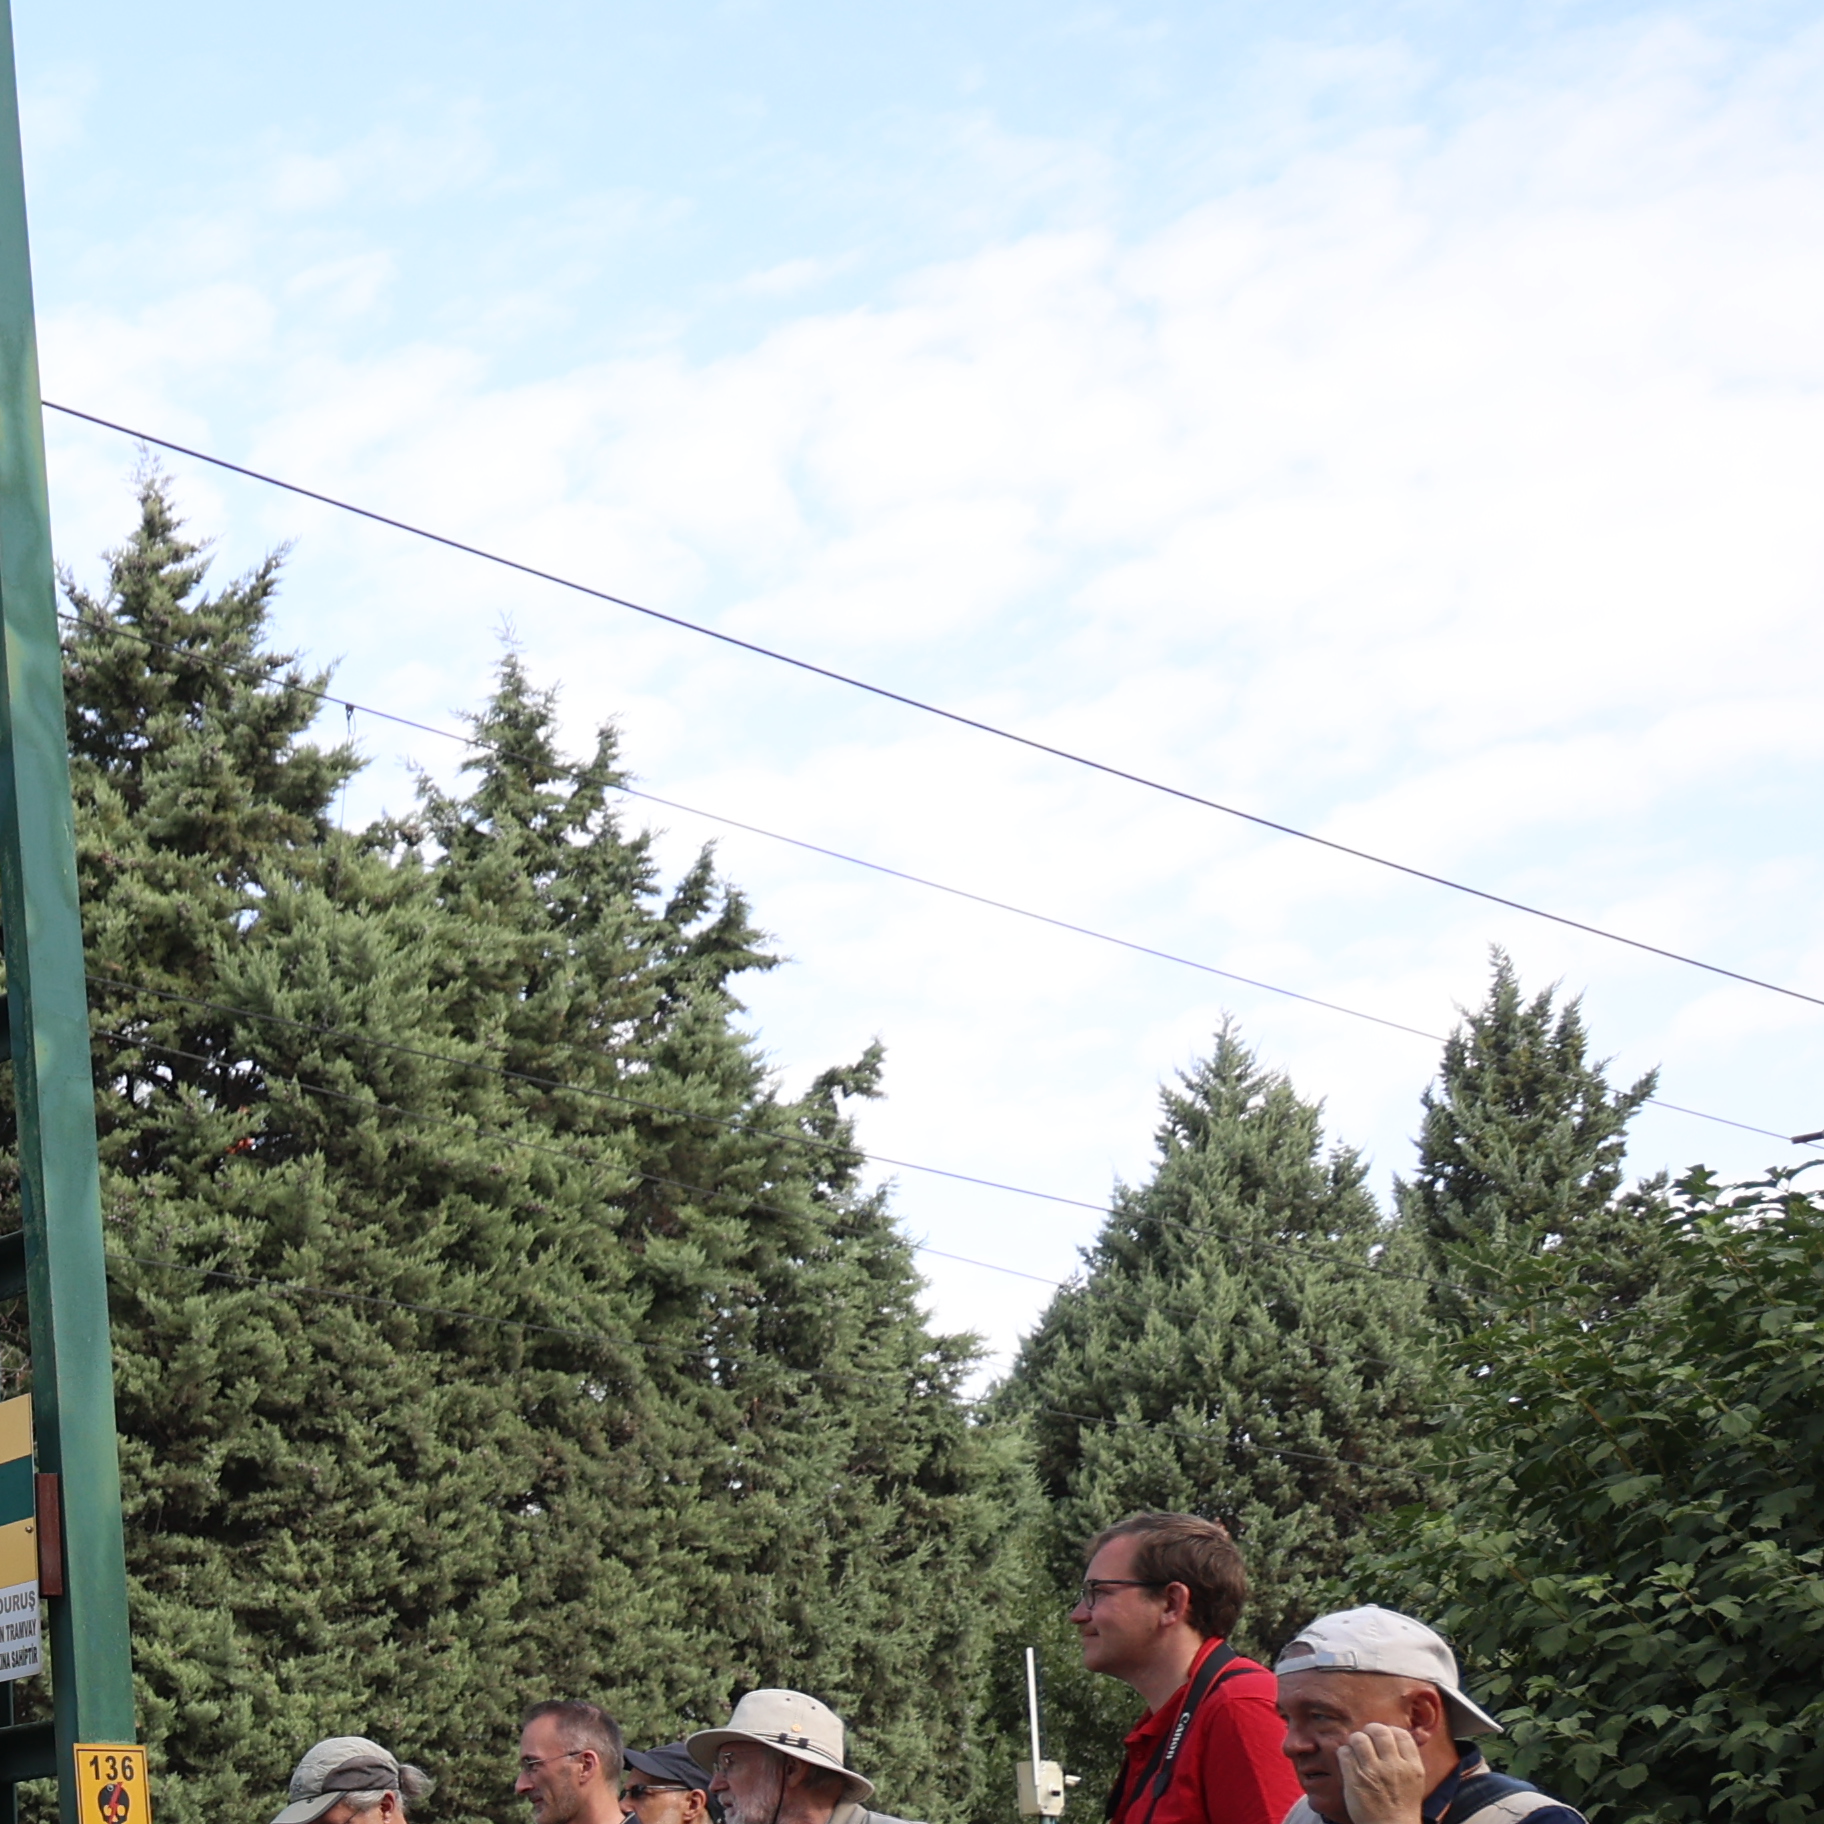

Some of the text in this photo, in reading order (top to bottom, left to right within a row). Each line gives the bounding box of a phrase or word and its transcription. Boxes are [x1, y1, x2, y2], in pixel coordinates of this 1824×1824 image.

[5, 1619, 37, 1640] TRAMVAY
[11, 1643, 39, 1668] SAHİPTİR
[1166, 1712, 1190, 1760] Canon
[89, 1755, 134, 1781] 136
